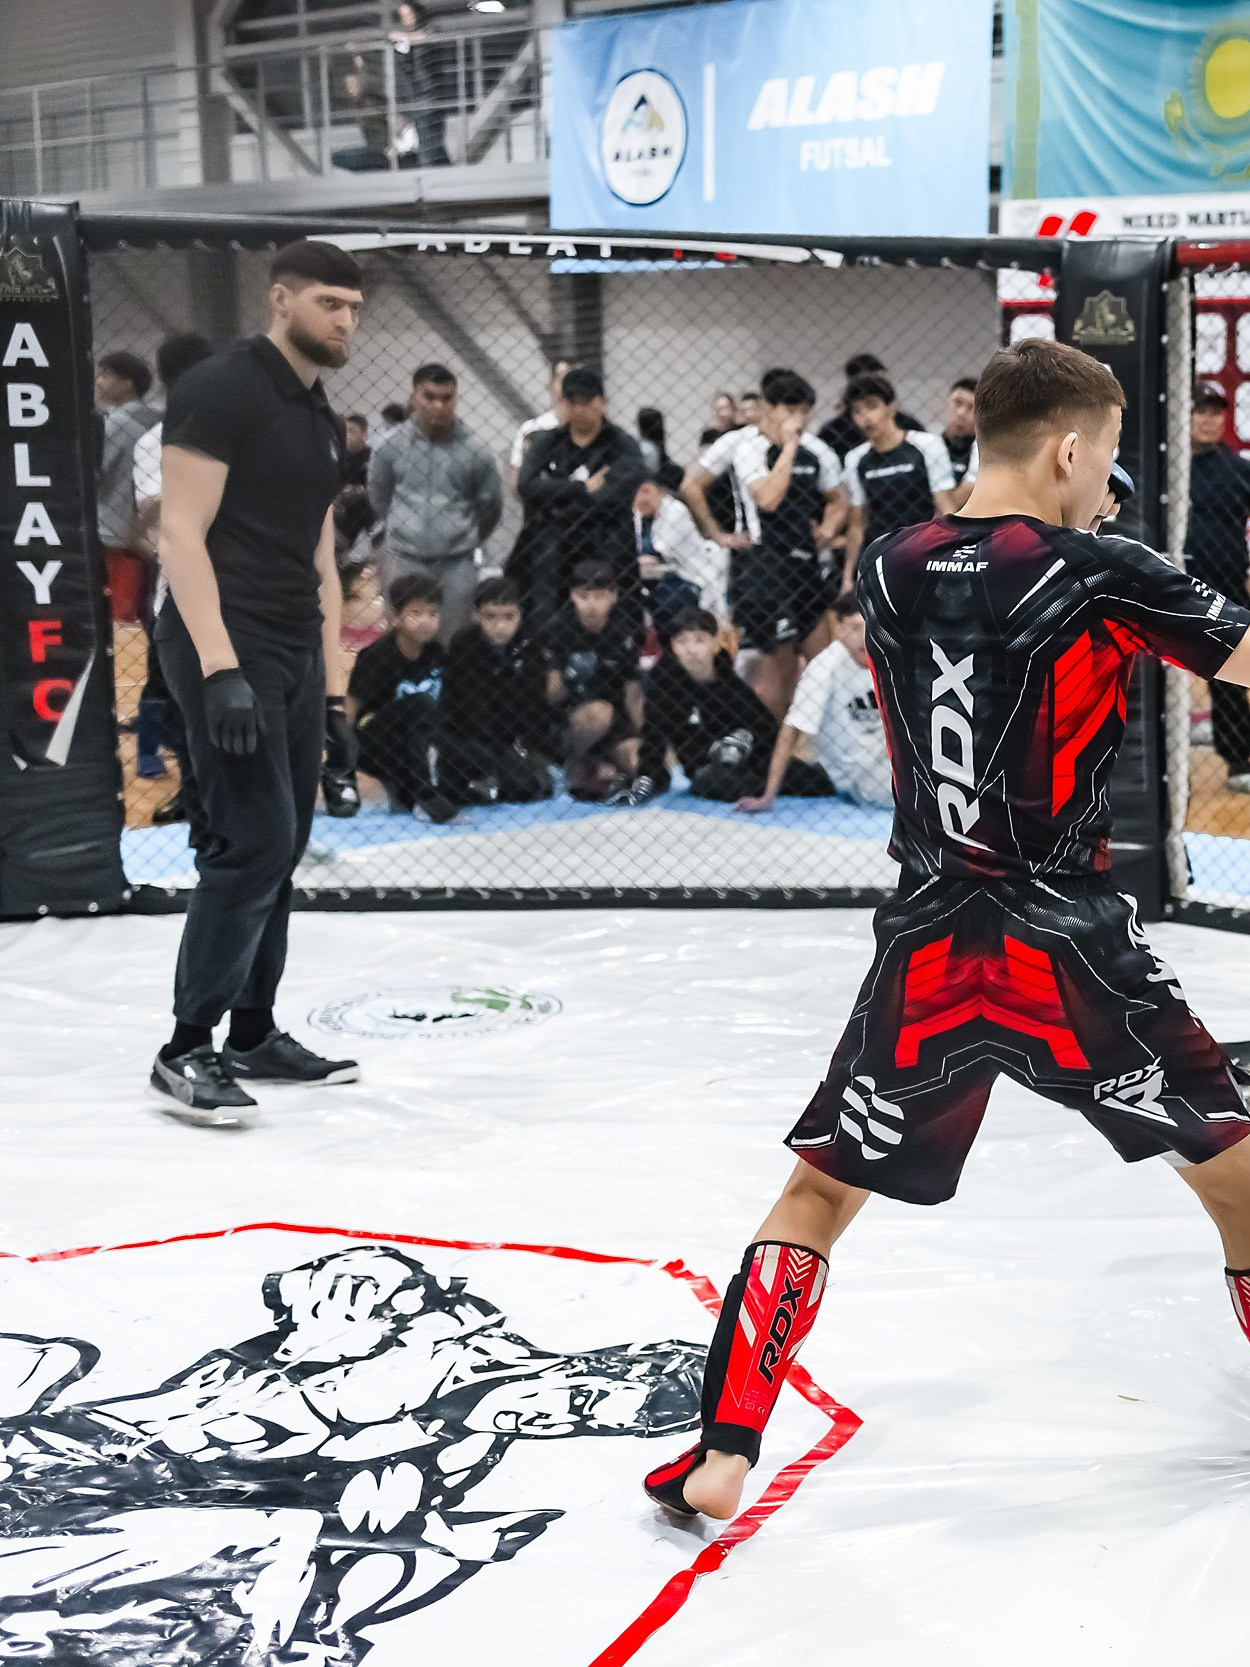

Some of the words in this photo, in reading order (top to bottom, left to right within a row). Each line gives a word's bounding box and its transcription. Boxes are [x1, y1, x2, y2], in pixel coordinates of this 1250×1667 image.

[747, 62, 945, 131] ALASH
[801, 135, 891, 172] FUTSAL
[2, 322, 63, 605] ABLAY
[926, 560, 989, 574] IMMAF
[930, 637, 995, 851] RDX
[1094, 1056, 1161, 1099] RDX
[757, 1274, 803, 1387] RDX
